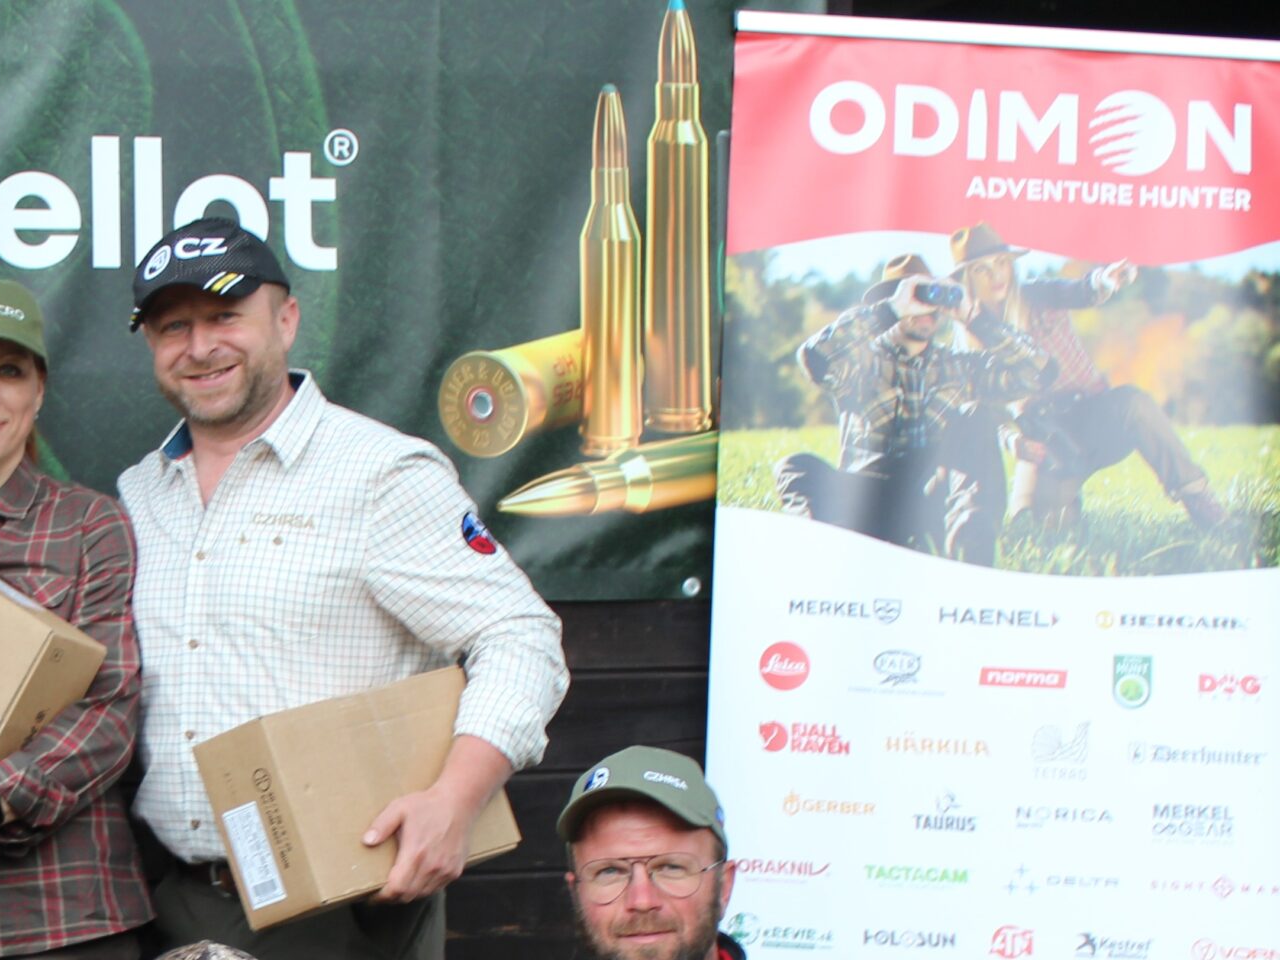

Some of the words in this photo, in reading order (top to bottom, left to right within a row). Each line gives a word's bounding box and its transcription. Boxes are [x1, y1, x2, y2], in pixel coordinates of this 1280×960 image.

[809, 80, 1253, 176] ODIMON
[966, 176, 1133, 206] ADVENTURE
[1139, 184, 1252, 211] HUNTER
[174, 237, 228, 260] CZ
[788, 599, 871, 619] MERKEL
[938, 607, 1050, 628] HAENEL
[761, 652, 808, 676] Leica
[986, 670, 1061, 687] norma
[1151, 745, 1265, 766] Deerhunter
[802, 799, 876, 815] GERBER
[1015, 806, 1114, 823] NORICA
[1152, 804, 1234, 821] MERKEL
[913, 814, 977, 832] TAURUS
[864, 864, 969, 883] TACTACAM
[1046, 875, 1120, 888] DELTA
